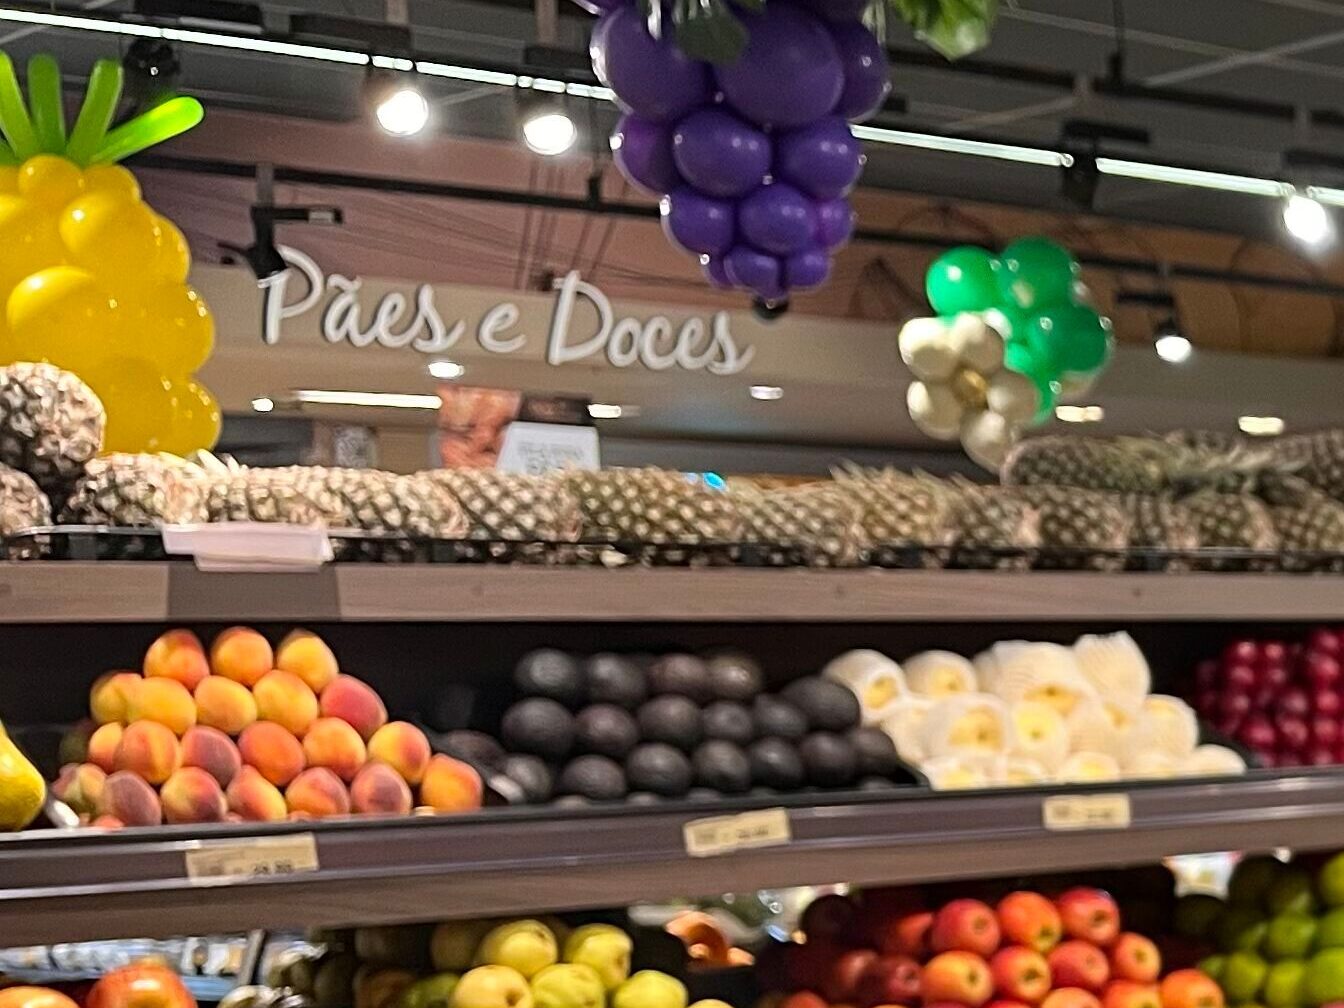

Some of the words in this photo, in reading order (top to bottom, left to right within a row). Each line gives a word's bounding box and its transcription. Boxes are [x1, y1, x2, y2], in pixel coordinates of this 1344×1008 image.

[257, 244, 464, 353] Pães
[478, 302, 526, 354] e
[547, 269, 755, 376] Doces
